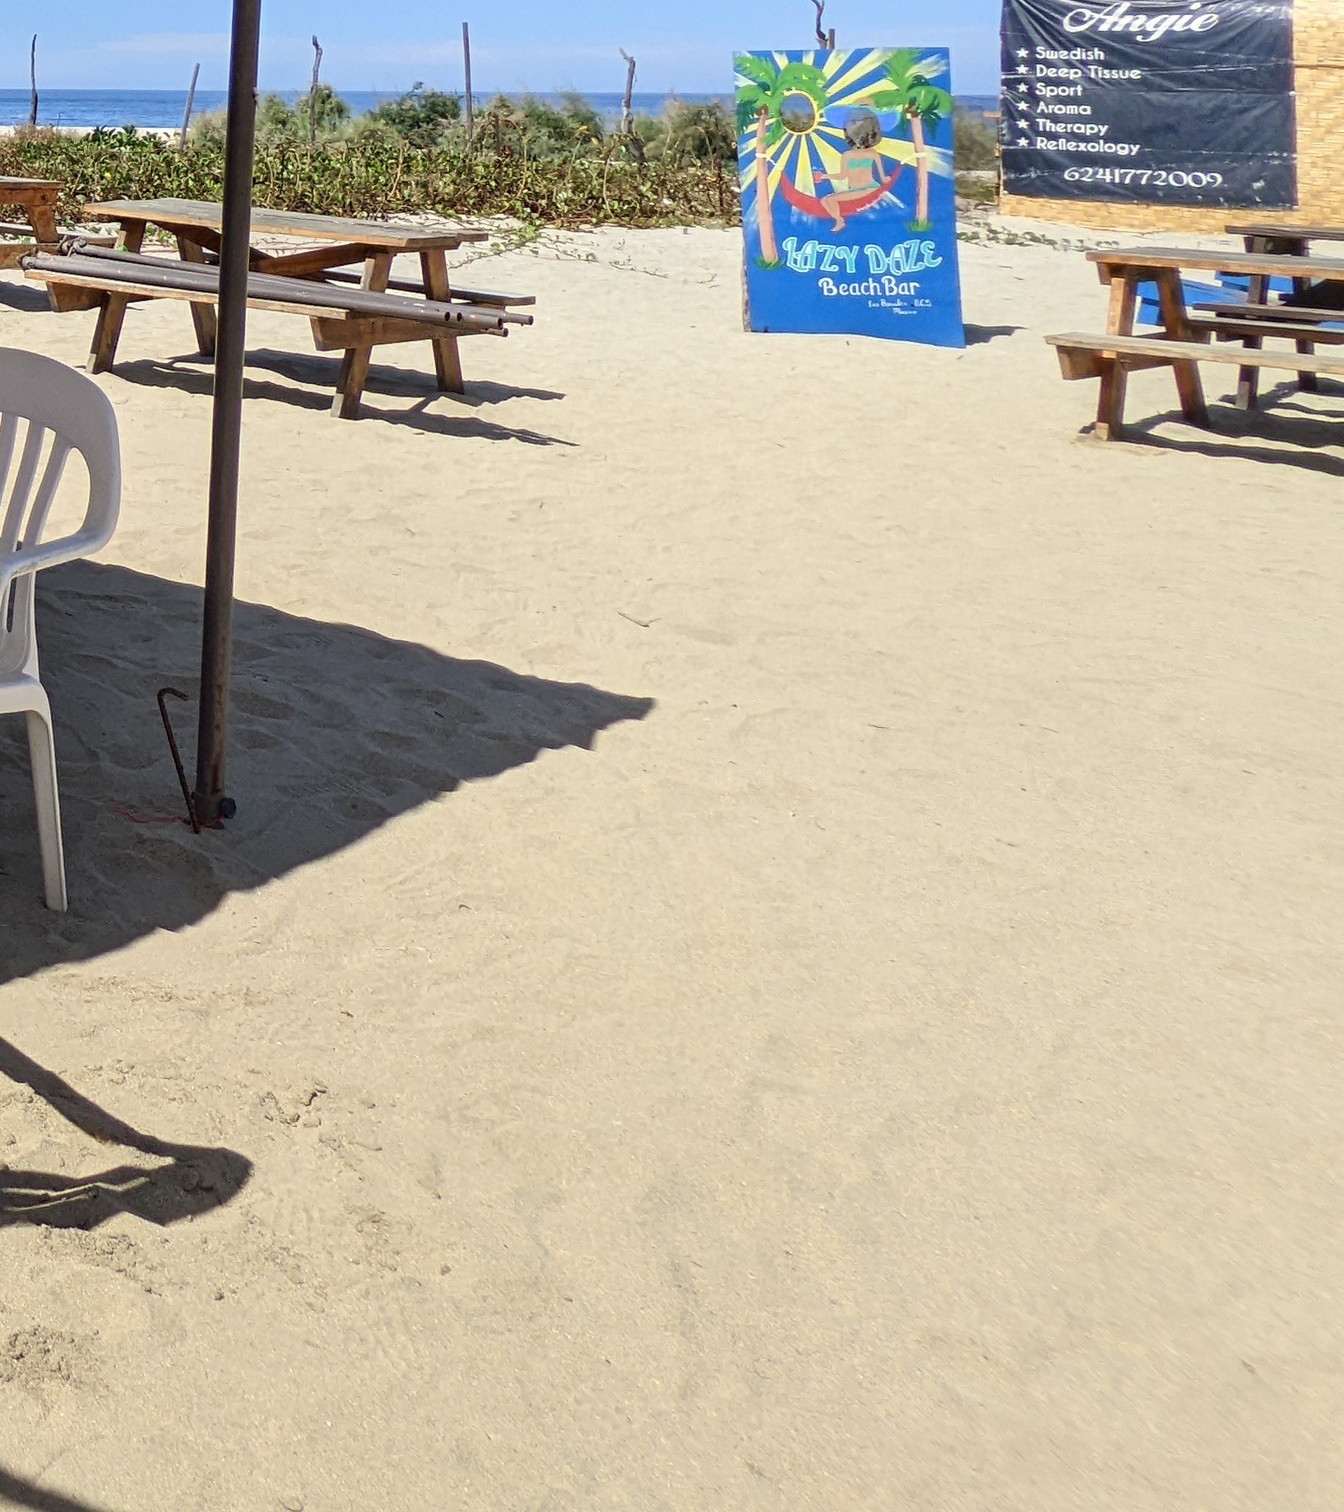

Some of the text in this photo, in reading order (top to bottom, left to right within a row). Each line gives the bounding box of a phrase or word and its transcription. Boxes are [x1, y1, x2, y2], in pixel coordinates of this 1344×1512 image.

[1062, 2, 1221, 42] Angie
[1035, 46, 1105, 60] Swedish
[1035, 64, 1141, 79] Deep Tissue
[1035, 82, 1083, 97] Sport
[1036, 101, 1092, 115] Aroma
[1035, 118, 1109, 136] Therapy
[1036, 136, 1141, 155] Reflexology
[1063, 166, 1223, 188] 6241772009
[782, 236, 943, 276] LAZY DAZE
[818, 275, 920, 296] Beach Bar
